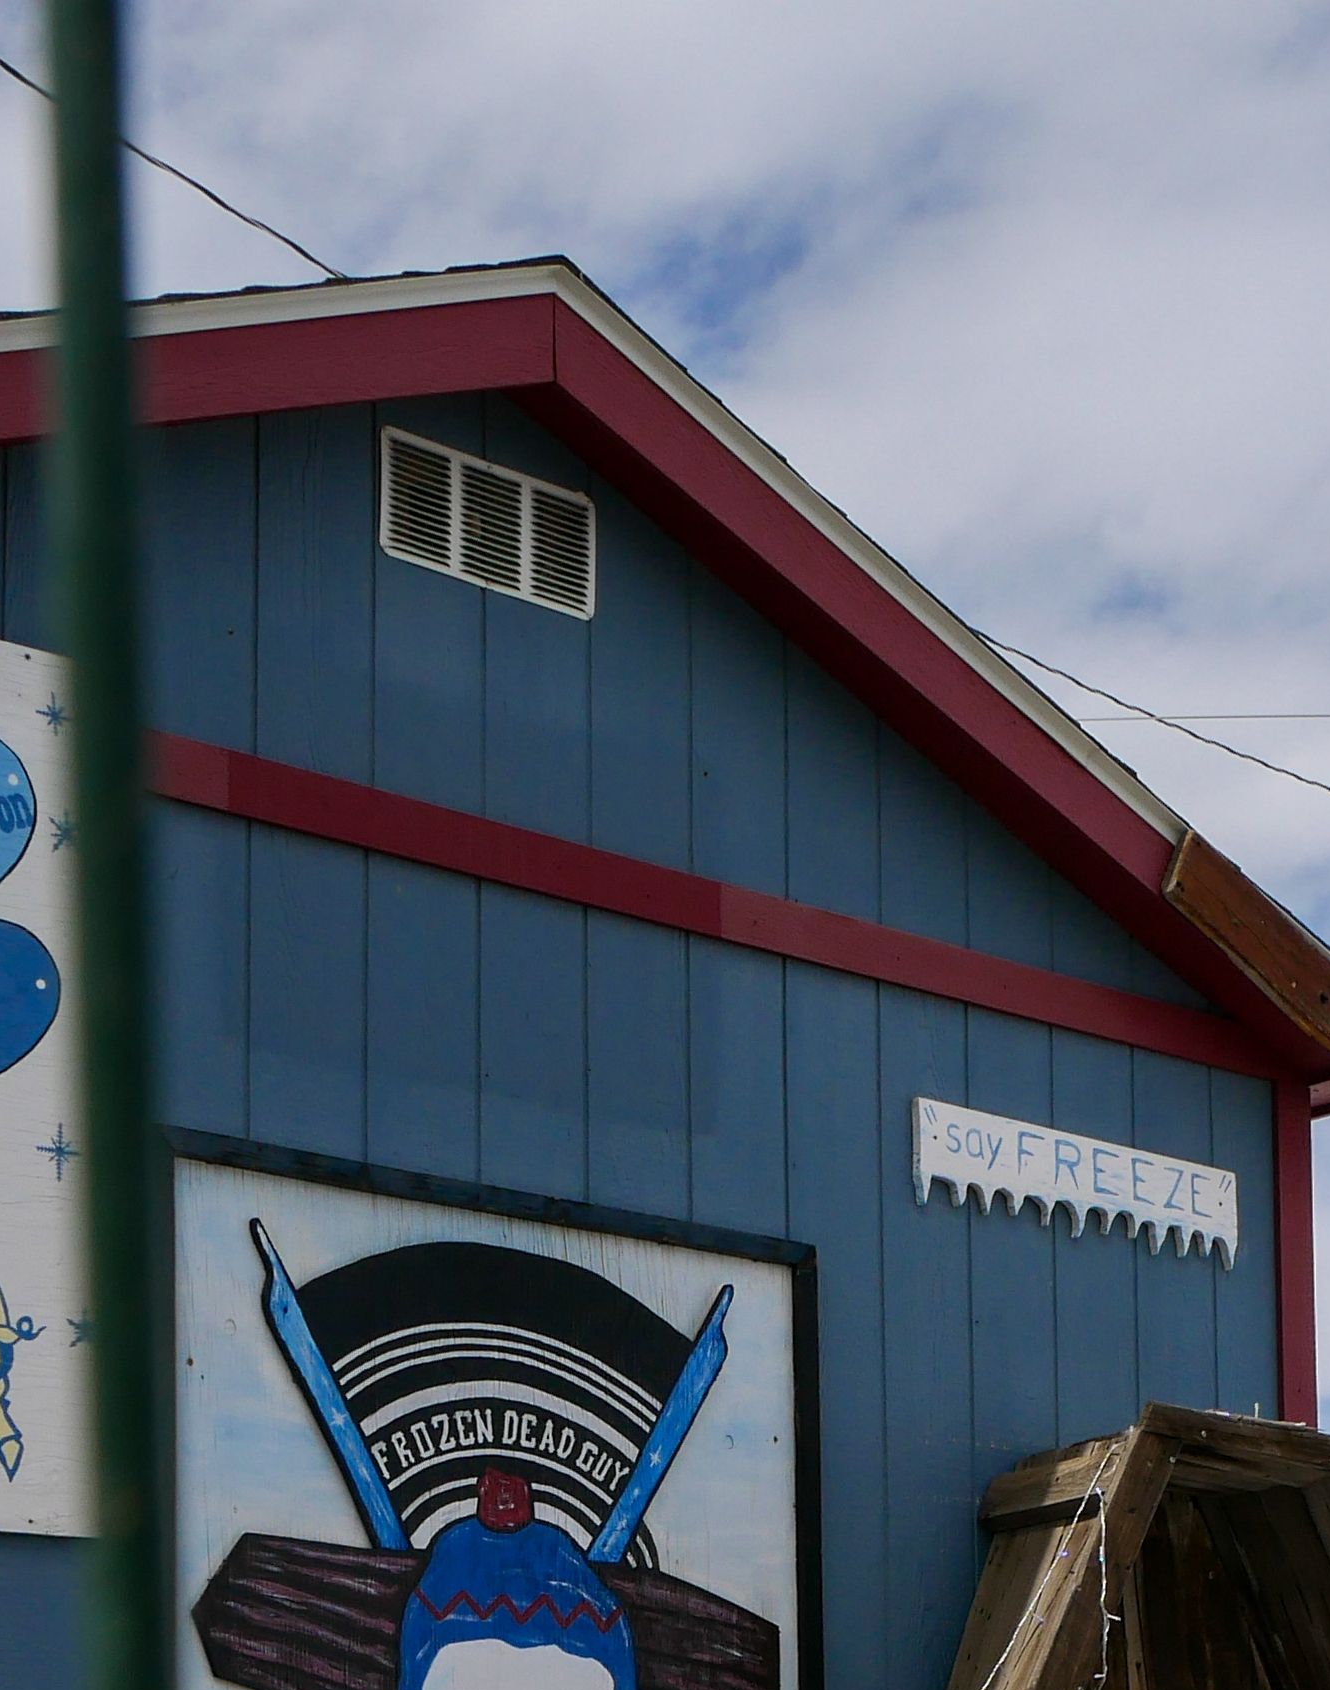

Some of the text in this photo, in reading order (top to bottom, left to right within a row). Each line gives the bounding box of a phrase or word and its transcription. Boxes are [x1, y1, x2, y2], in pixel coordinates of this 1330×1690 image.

[371, 1408, 631, 1491] FROZEN DEAD GUY
